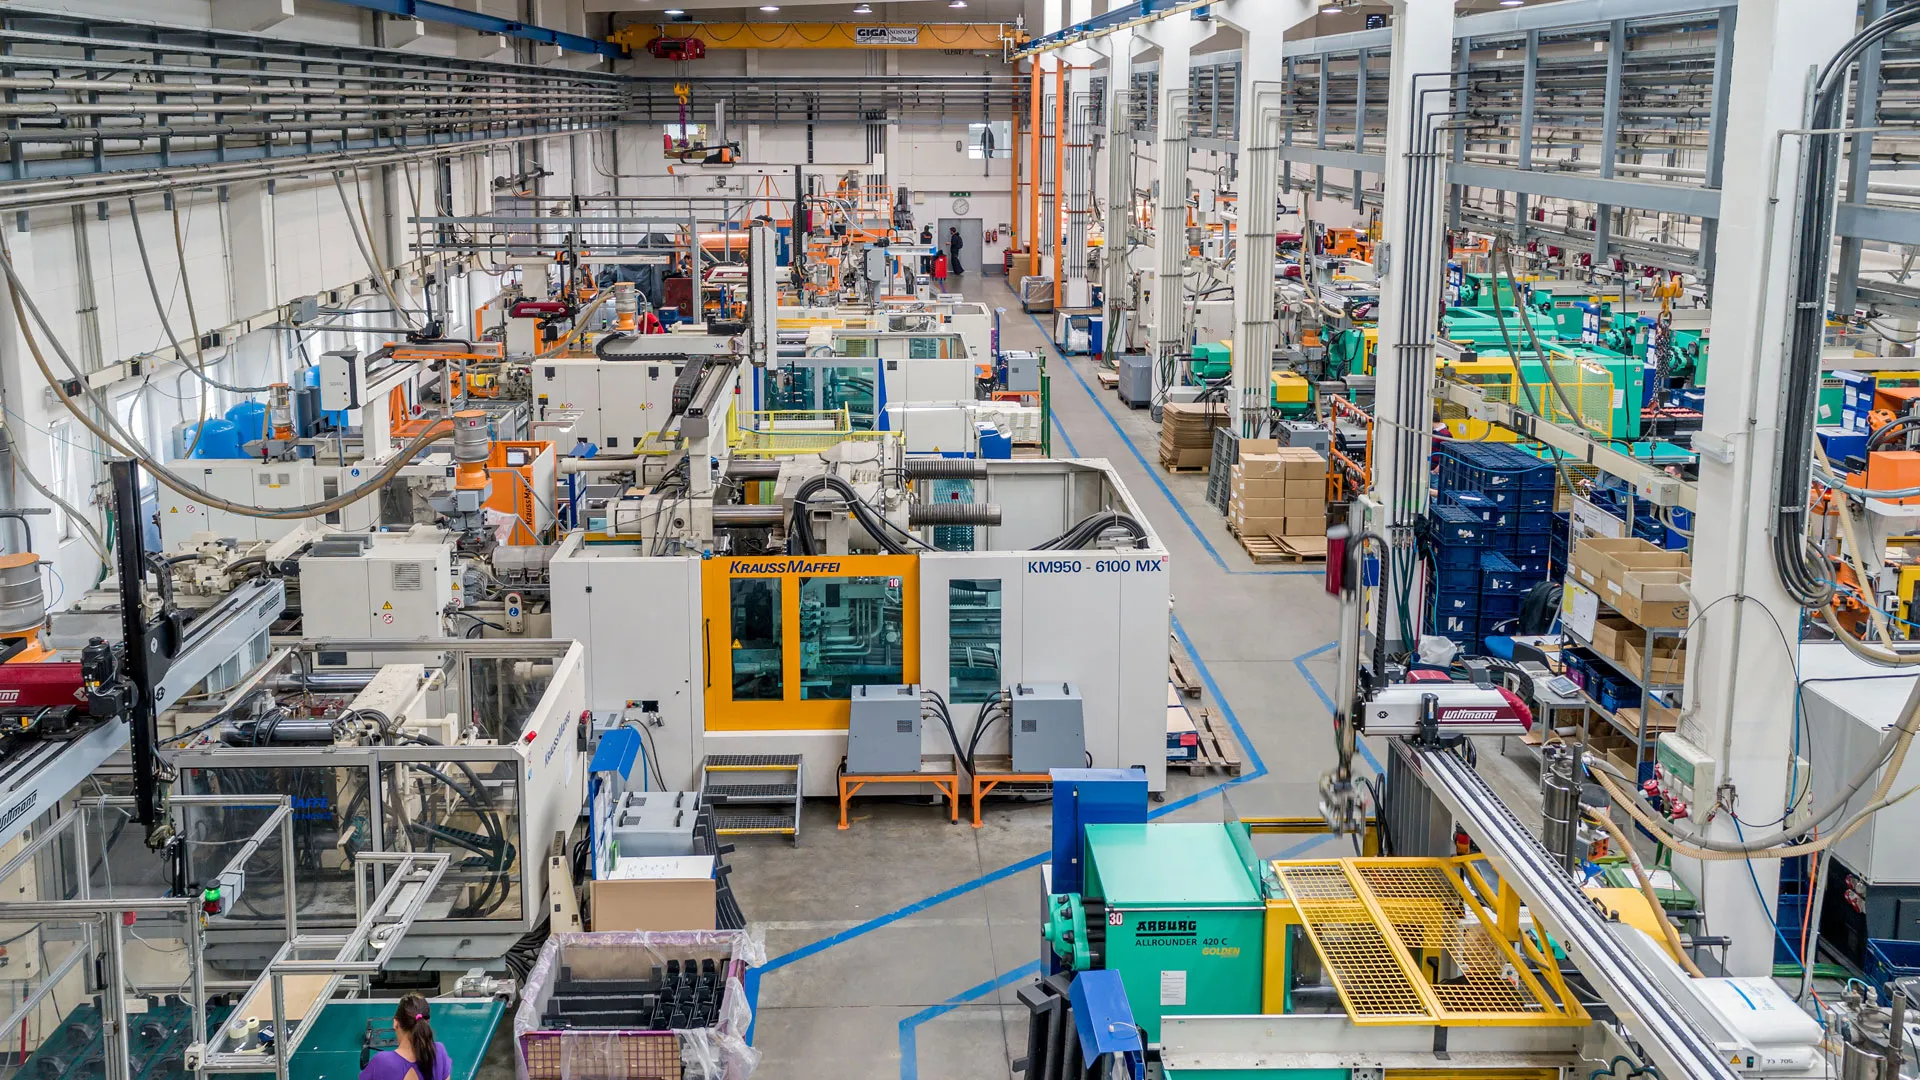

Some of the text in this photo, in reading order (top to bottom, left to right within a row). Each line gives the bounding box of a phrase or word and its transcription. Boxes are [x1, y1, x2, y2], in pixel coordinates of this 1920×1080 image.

[857, 28, 887, 37] GIGA
[1028, 560, 1082, 573] KM950
[1095, 560, 1131, 573] 6100
[1136, 560, 1162, 572] MX
[889, 578, 899, 588] 10
[1109, 912, 1123, 926] 30
[1136, 920, 1197, 932] ARBURG
[1135, 938, 1228, 947] ALLROUNDER 420 C
[1202, 947, 1240, 956] GOLDEN
